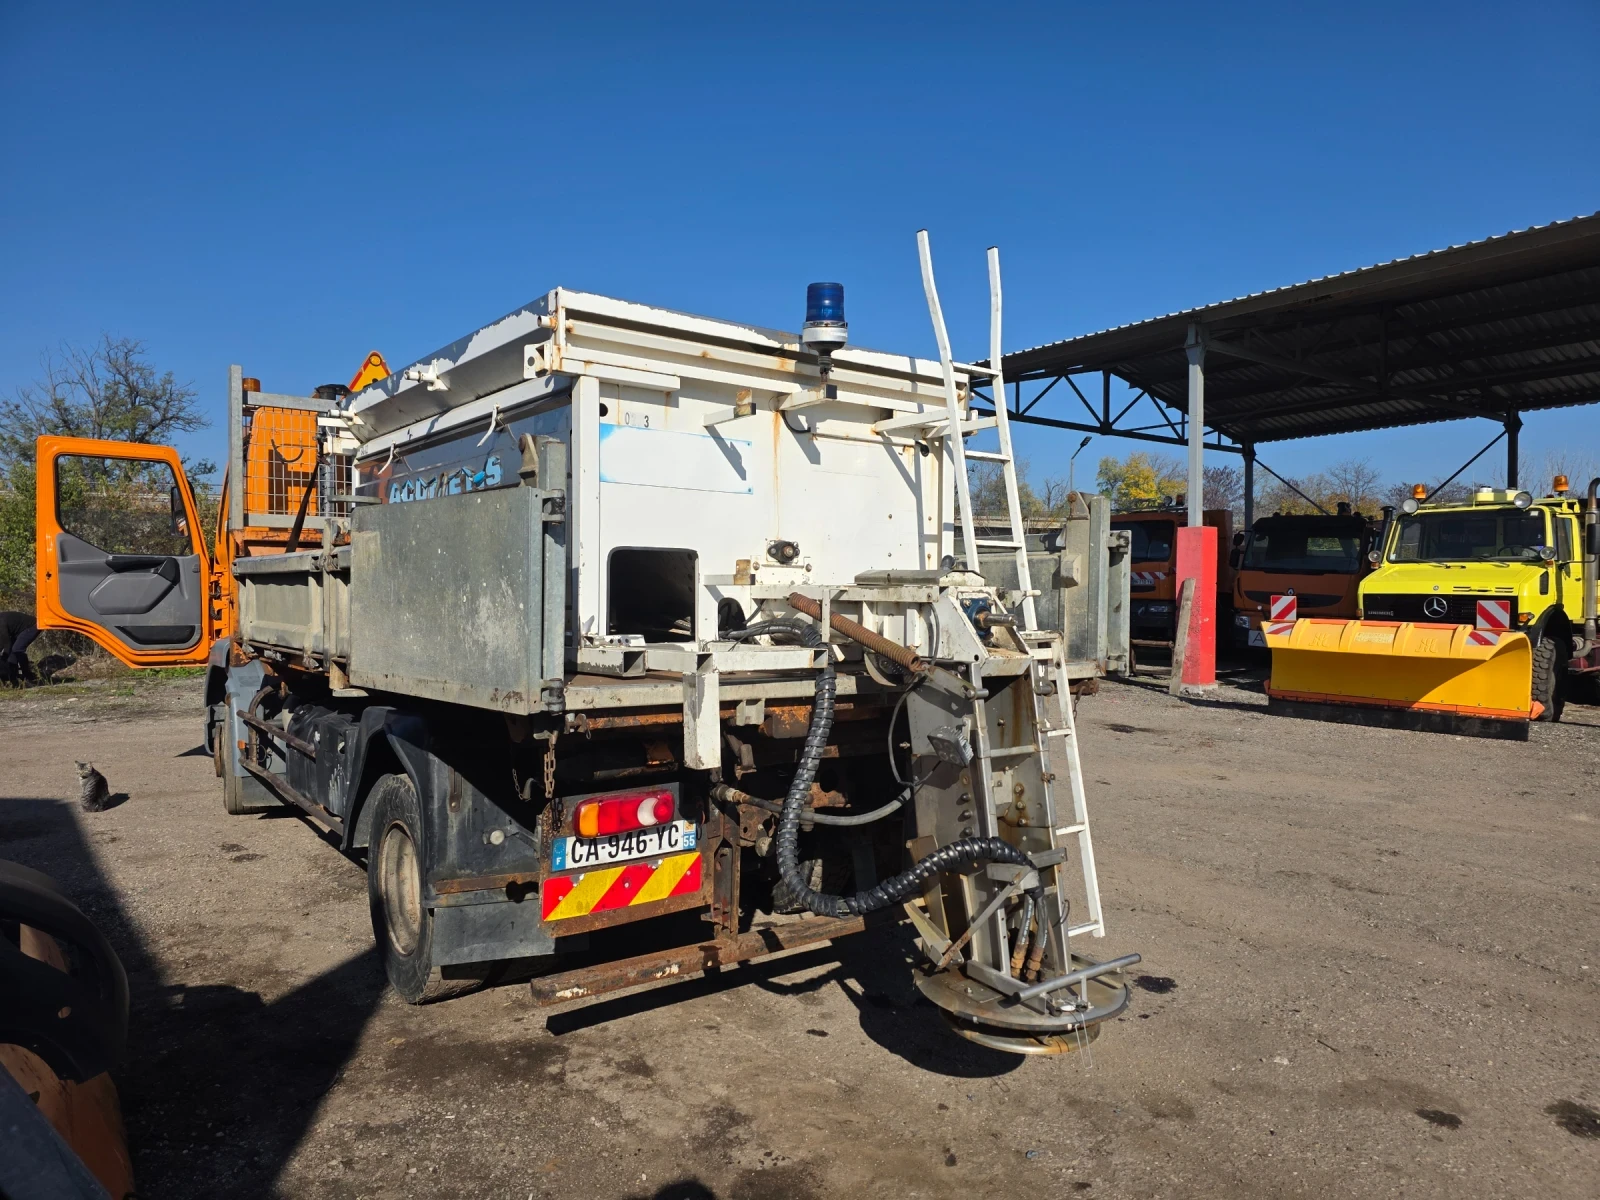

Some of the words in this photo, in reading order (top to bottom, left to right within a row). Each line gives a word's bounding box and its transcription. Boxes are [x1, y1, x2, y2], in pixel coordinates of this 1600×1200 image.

[1252, 632, 1265, 644] A
[571, 824, 679, 864] CA-946-YC
[683, 834, 695, 847] 55
[556, 857, 562, 866] F
